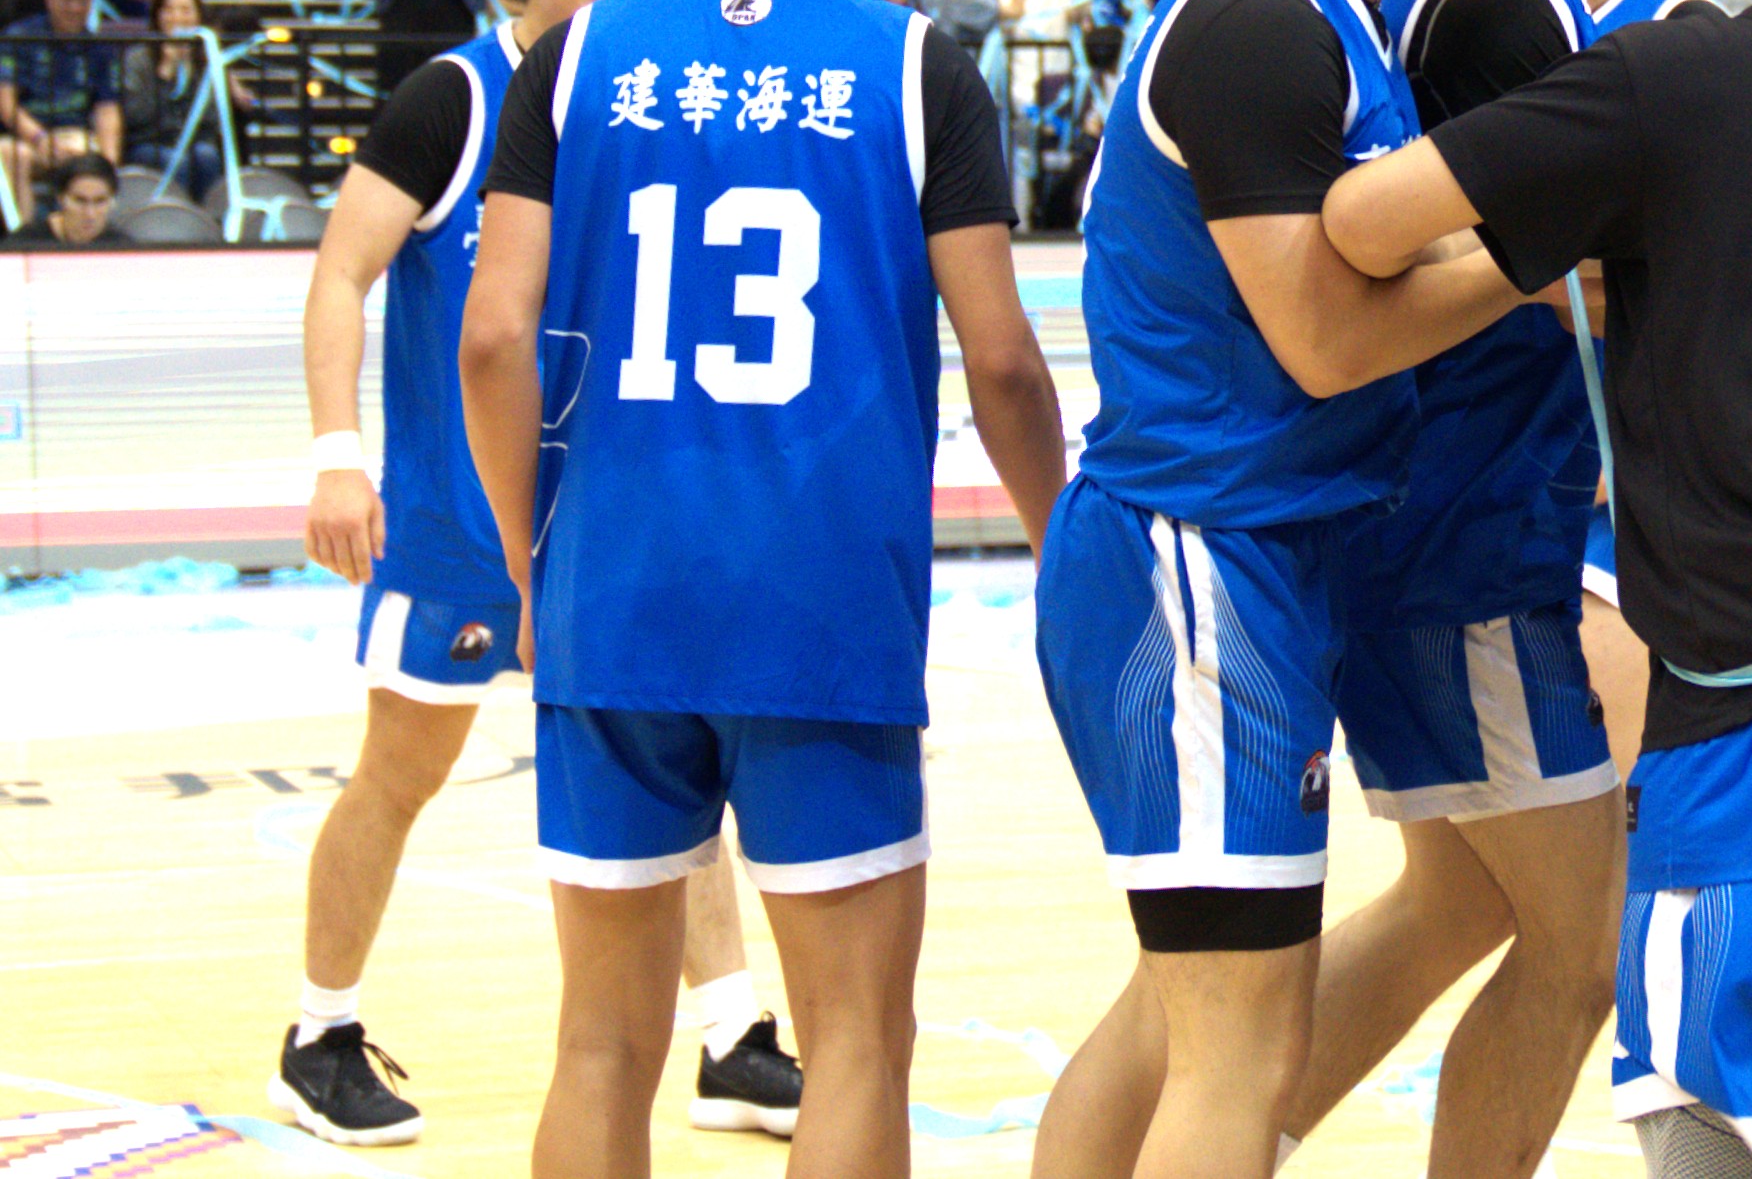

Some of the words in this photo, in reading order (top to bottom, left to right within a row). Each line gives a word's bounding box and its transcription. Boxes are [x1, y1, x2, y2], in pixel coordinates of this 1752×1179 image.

[608, 58, 857, 140] 建華海運
[618, 183, 821, 405] 13
